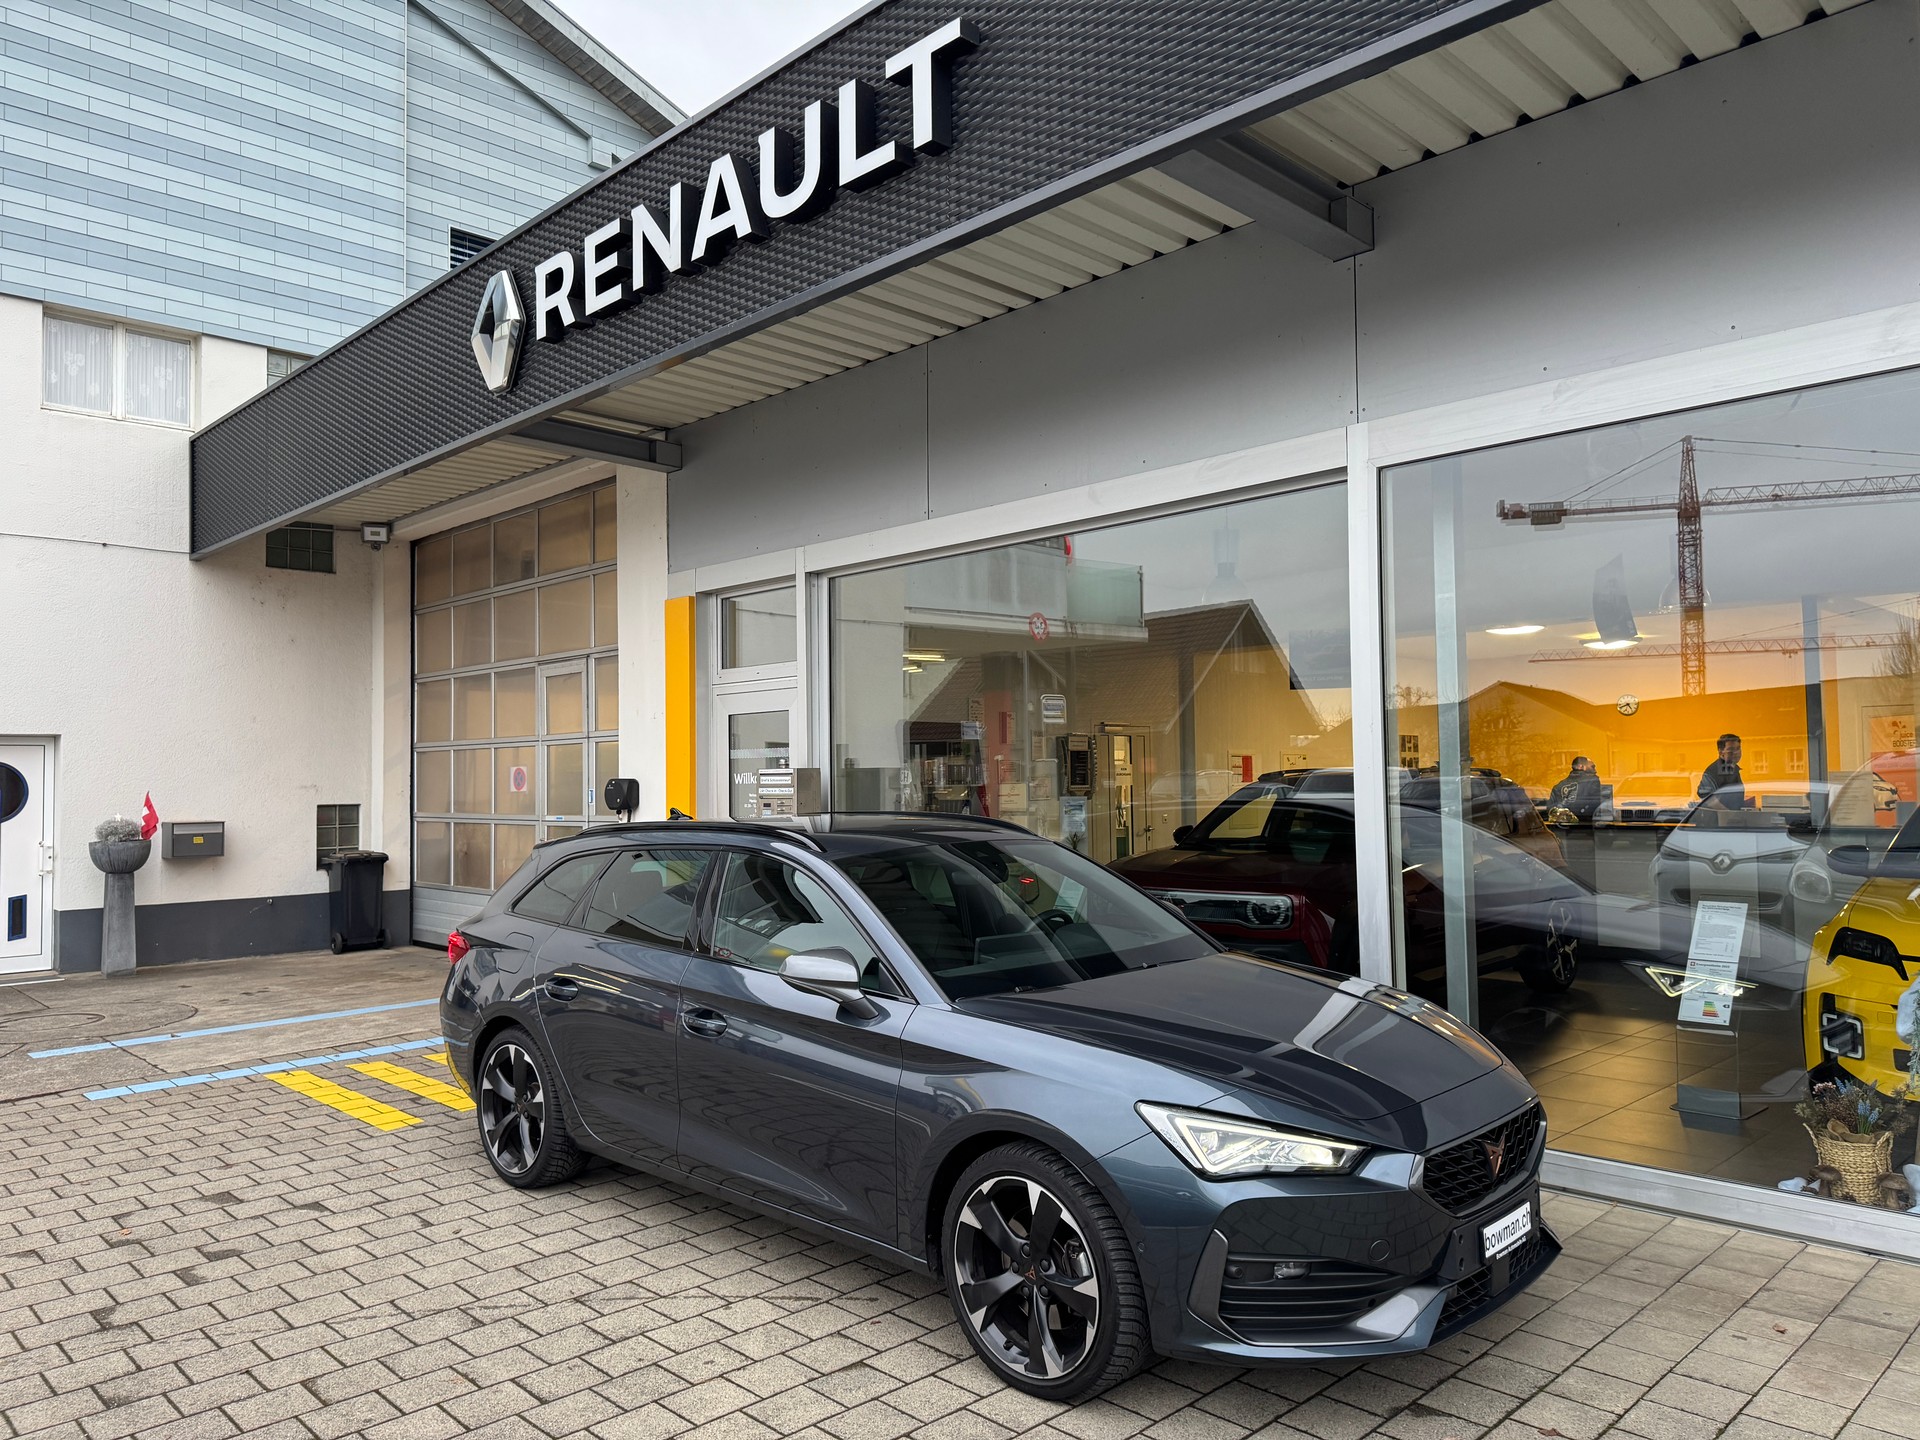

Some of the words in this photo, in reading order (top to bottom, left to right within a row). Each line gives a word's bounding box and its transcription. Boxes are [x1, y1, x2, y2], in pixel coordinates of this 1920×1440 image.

[535, 17, 963, 341] RENAULT
[734, 772, 757, 785] Willk
[1484, 1207, 1531, 1251] bowman.ch
